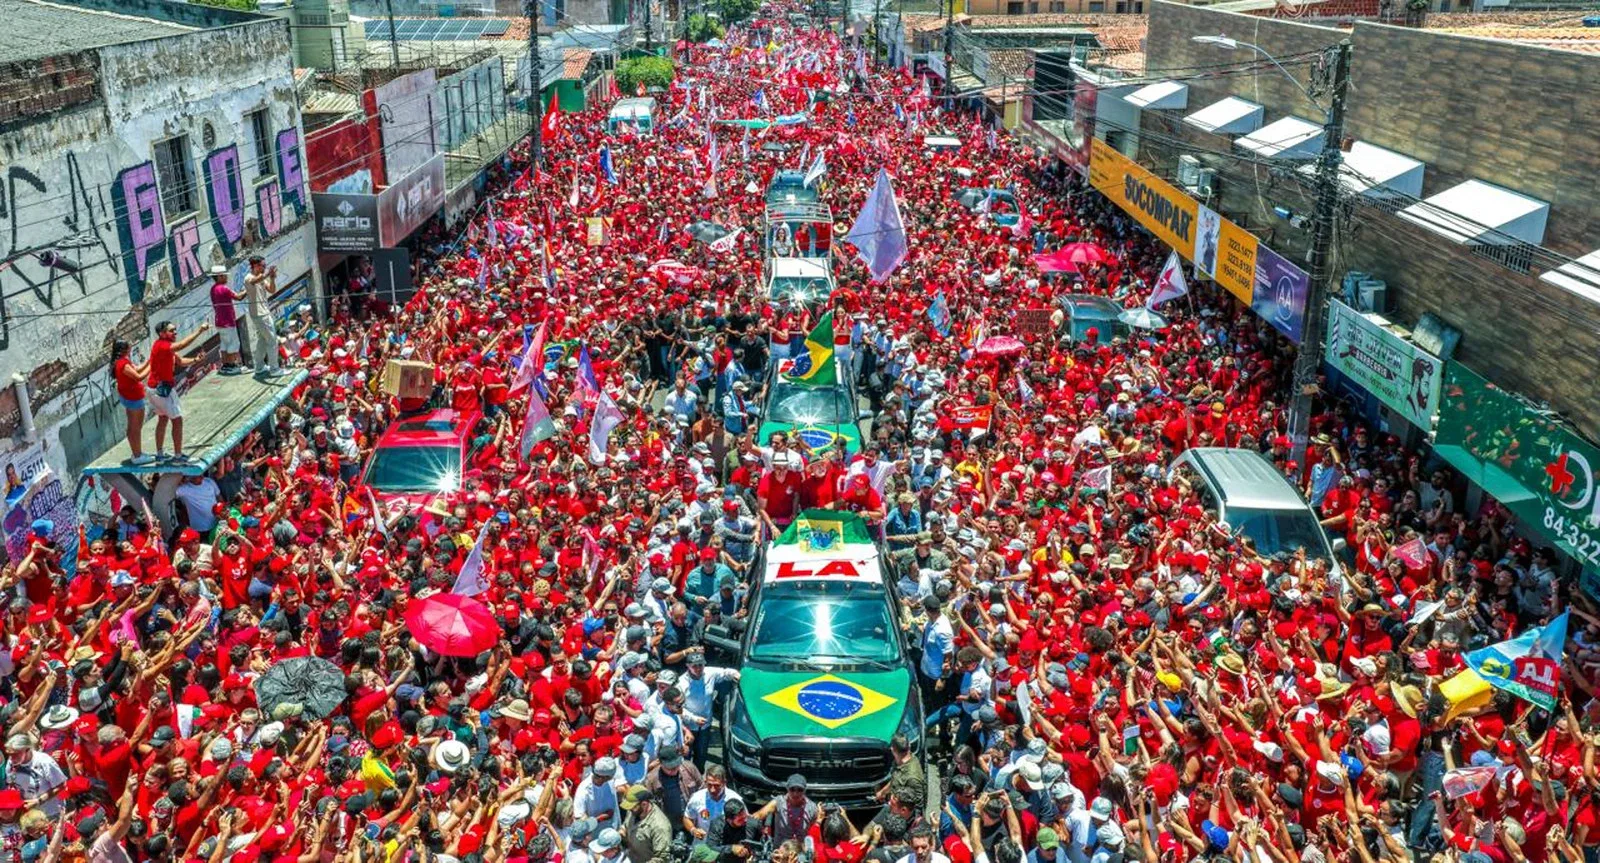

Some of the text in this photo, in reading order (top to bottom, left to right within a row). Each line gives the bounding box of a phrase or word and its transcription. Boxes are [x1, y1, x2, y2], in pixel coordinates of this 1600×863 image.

[1125, 173, 1190, 243] SOCOMPAR
[21, 457, 46, 482] 45111
[776, 559, 860, 578] LA
[800, 760, 853, 768] RAM
